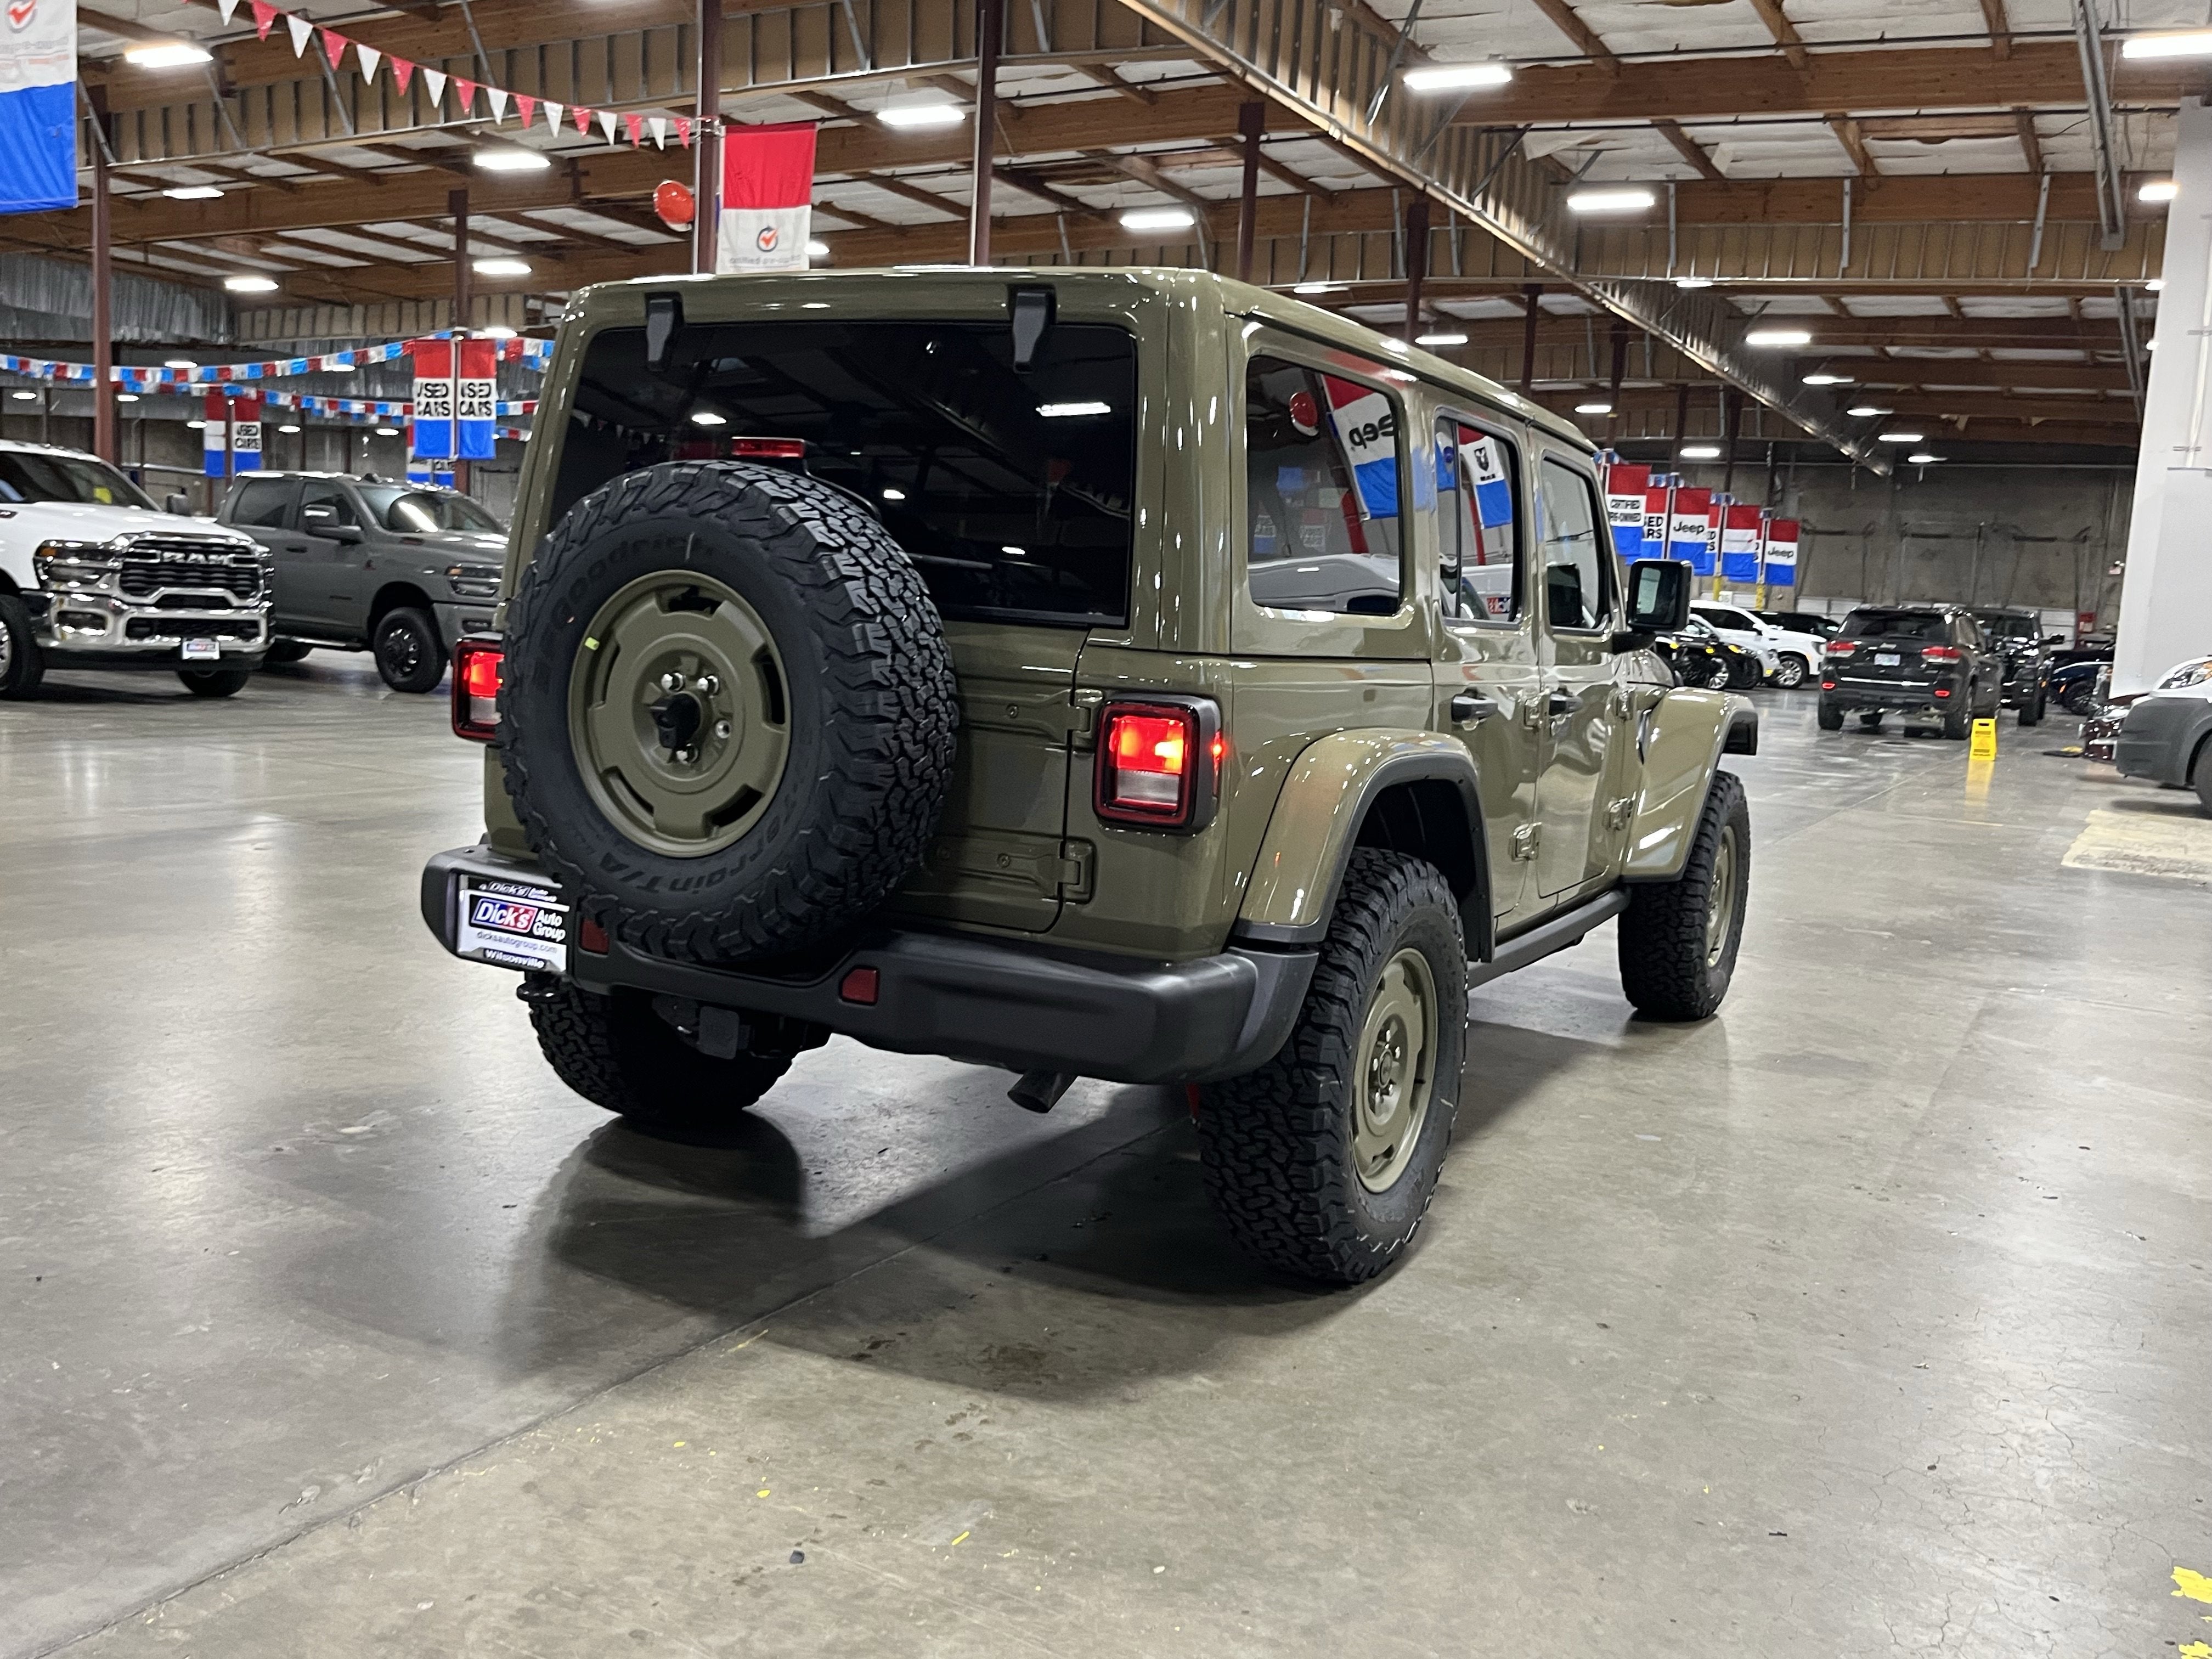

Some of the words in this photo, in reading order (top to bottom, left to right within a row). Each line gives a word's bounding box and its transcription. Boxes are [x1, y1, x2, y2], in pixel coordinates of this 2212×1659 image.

[1673, 521, 1705, 535] Jeep
[163, 552, 230, 566] RAM
[1768, 546, 1795, 559] Jeep
[476, 902, 532, 929] Dick's
[535, 909, 563, 928] Auto
[532, 922, 566, 943] Group
[485, 949, 545, 969] Wilsonville
